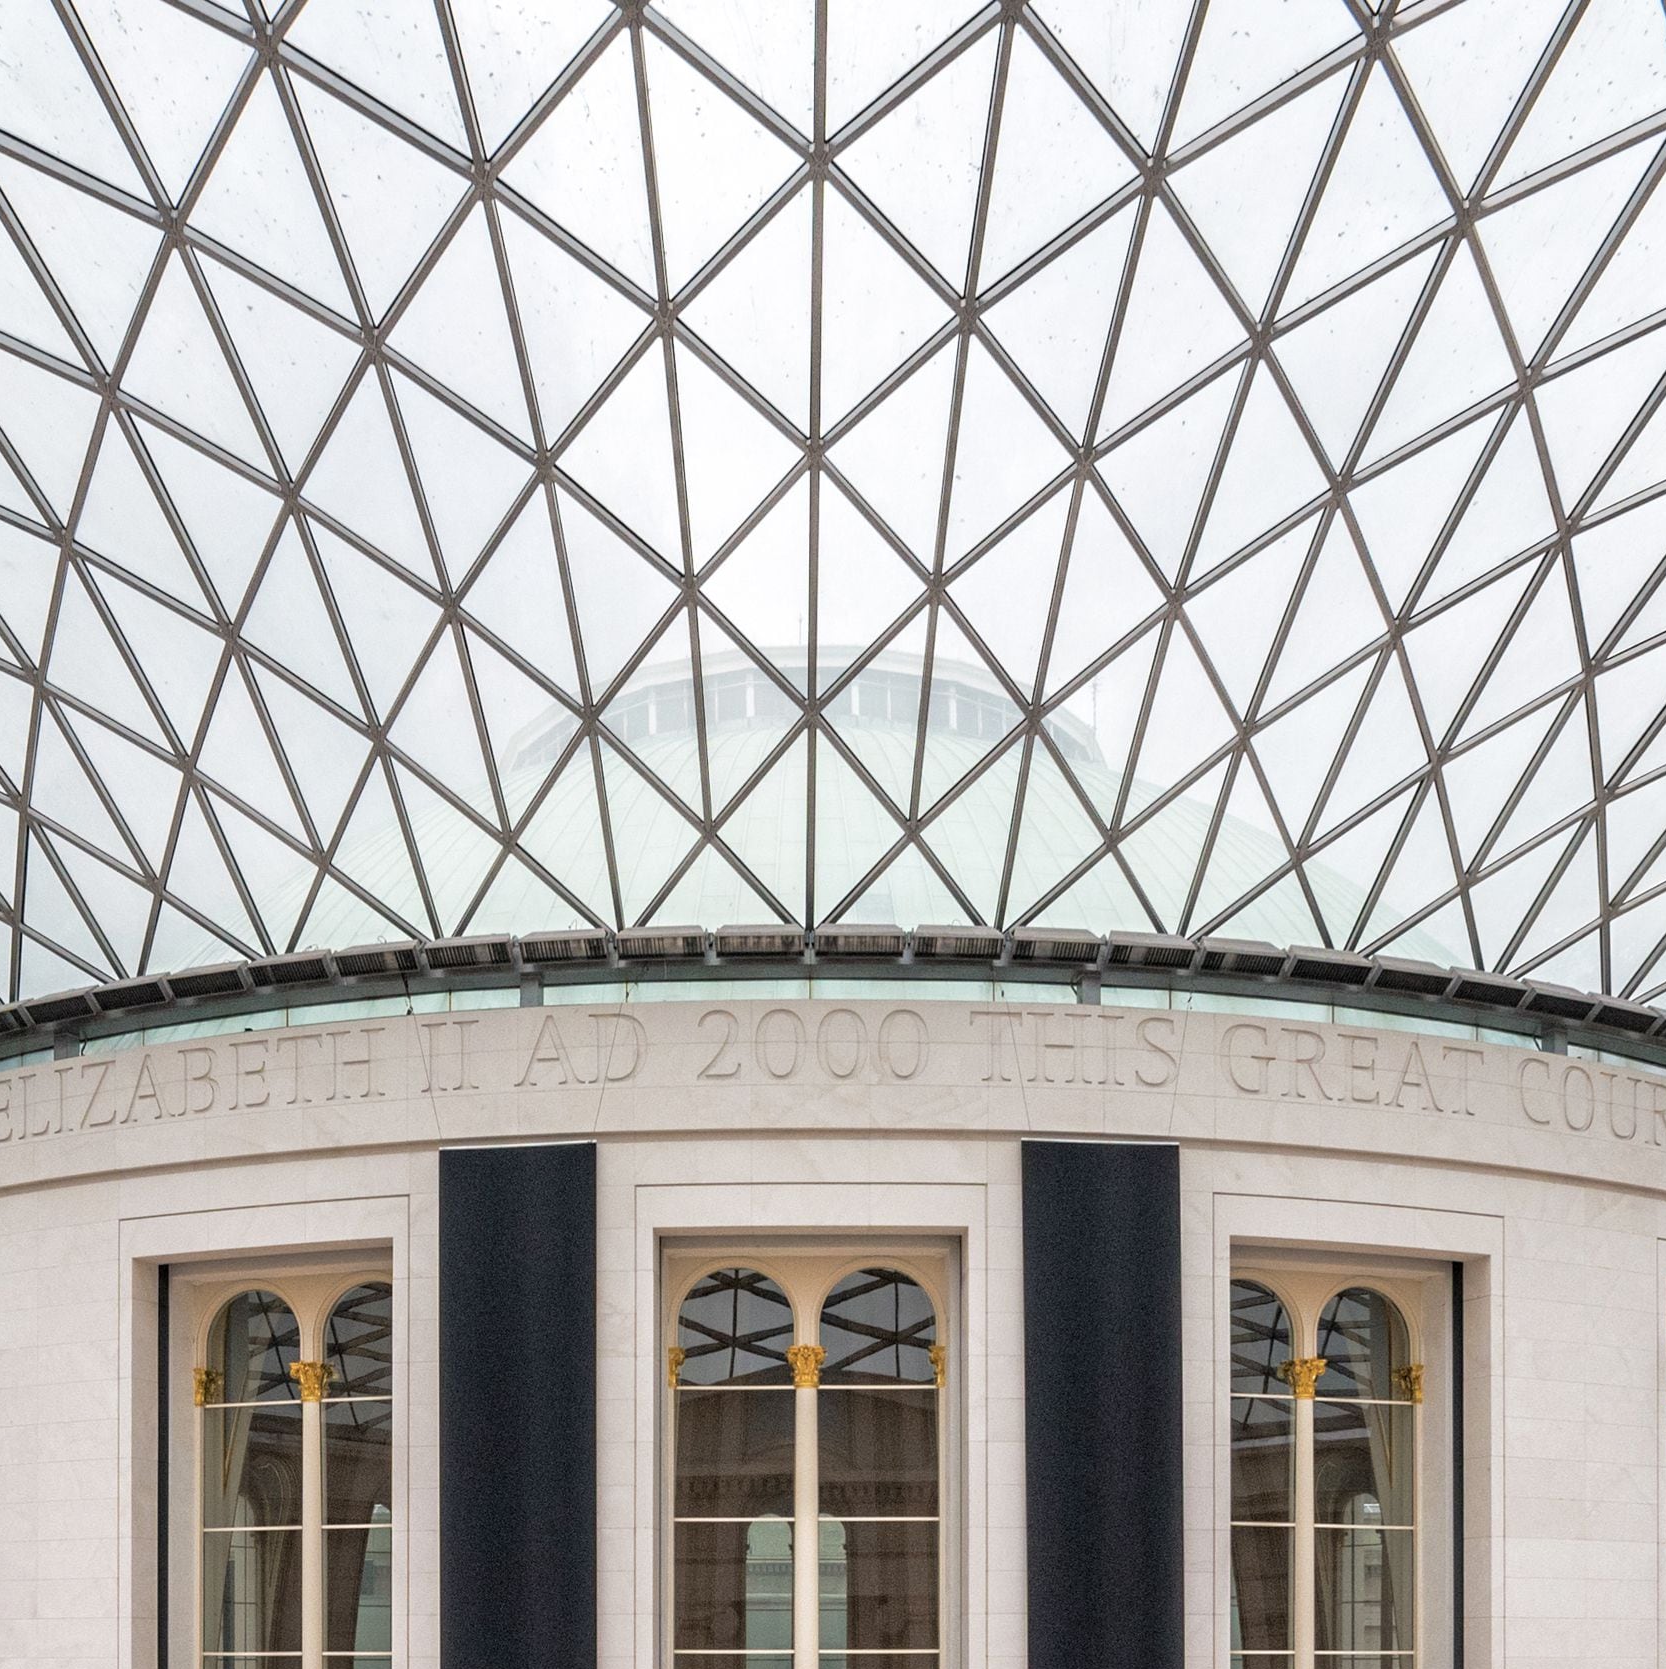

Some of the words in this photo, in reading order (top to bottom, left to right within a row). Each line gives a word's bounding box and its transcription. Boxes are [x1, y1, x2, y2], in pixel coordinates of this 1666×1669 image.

[412, 1019, 483, 1093] II
[514, 1009, 648, 1090] AD
[698, 1008, 930, 1082] 2000
[969, 1009, 1179, 1088] THIS
[1219, 1022, 1486, 1118] GREAT
